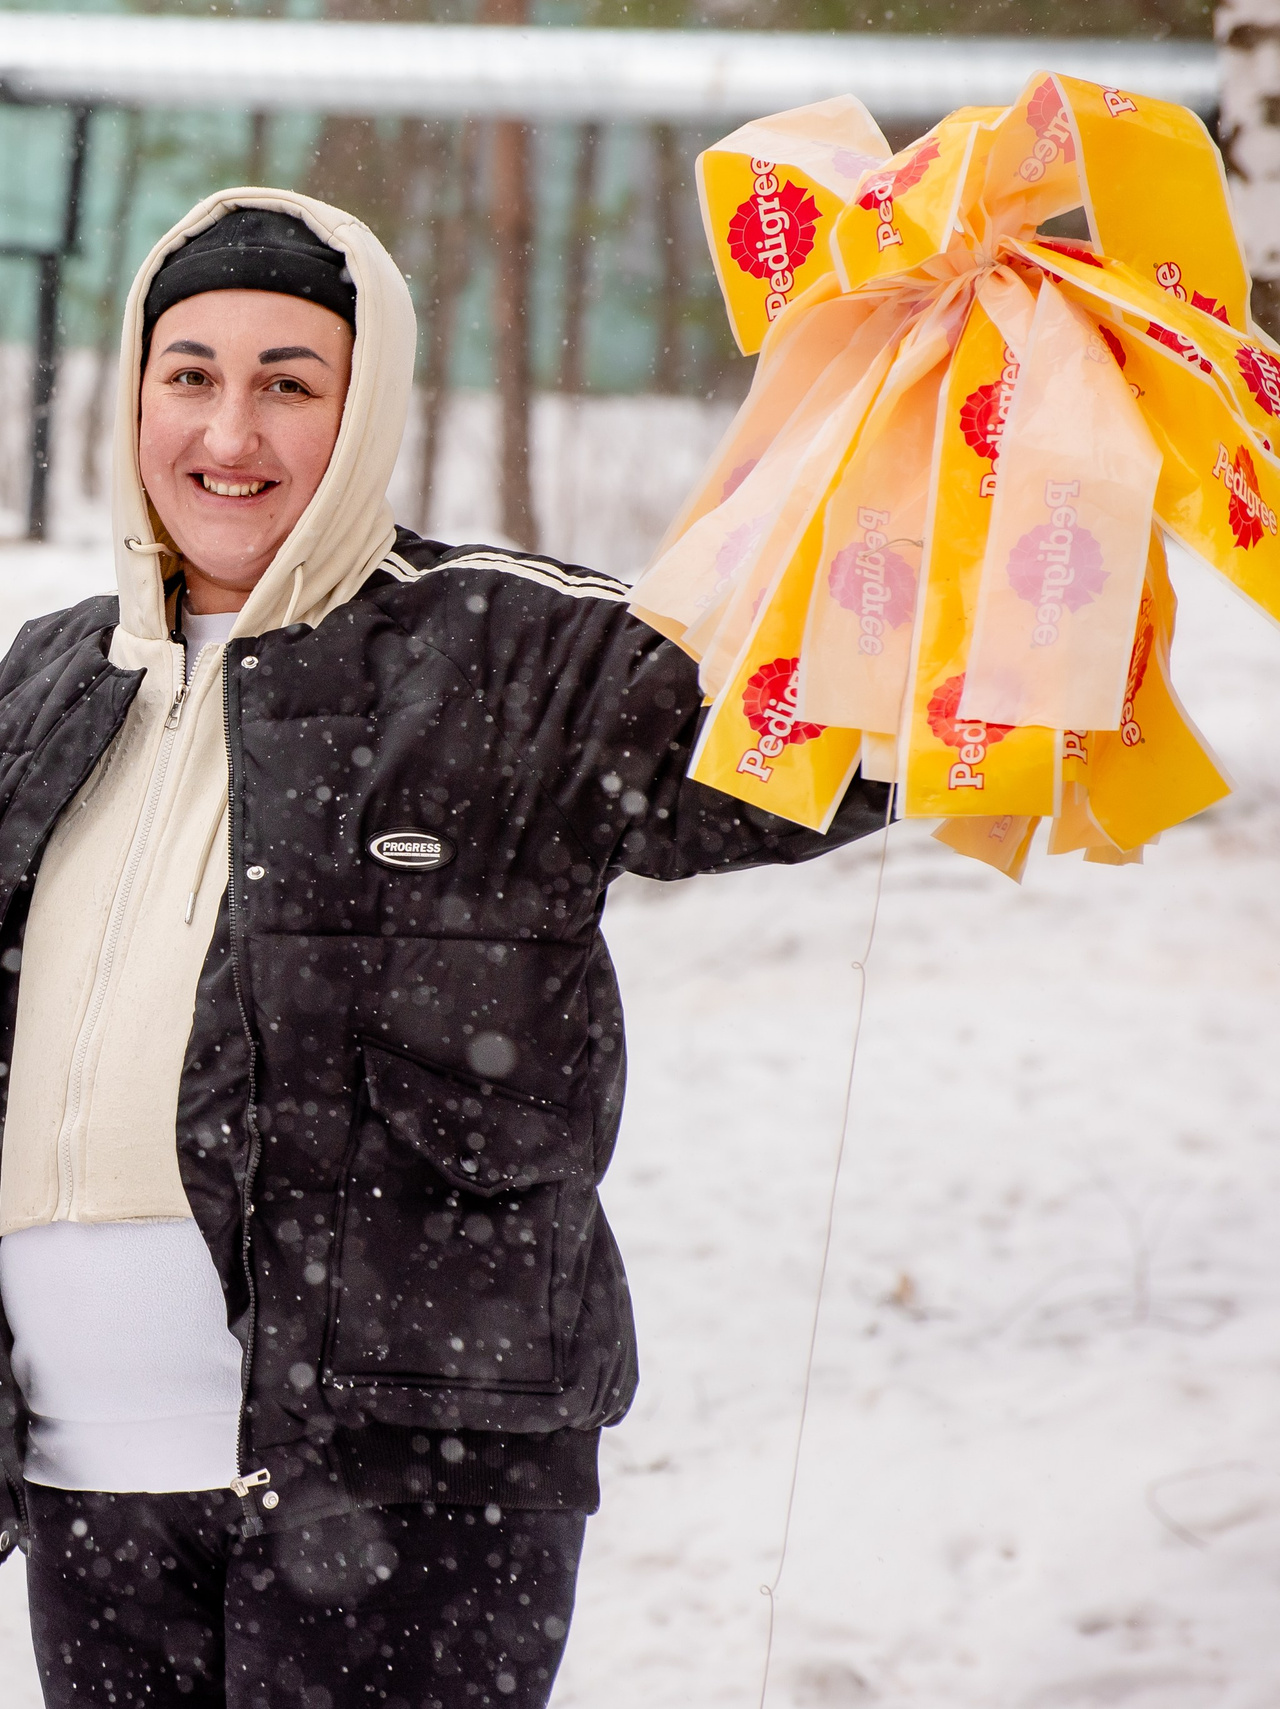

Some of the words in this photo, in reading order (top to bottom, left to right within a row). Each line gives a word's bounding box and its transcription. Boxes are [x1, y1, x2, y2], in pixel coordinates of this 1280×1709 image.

[750, 157, 794, 322] Pedigree
[1212, 441, 1277, 536] Pedigree
[382, 841, 441, 853] PROGRESS
